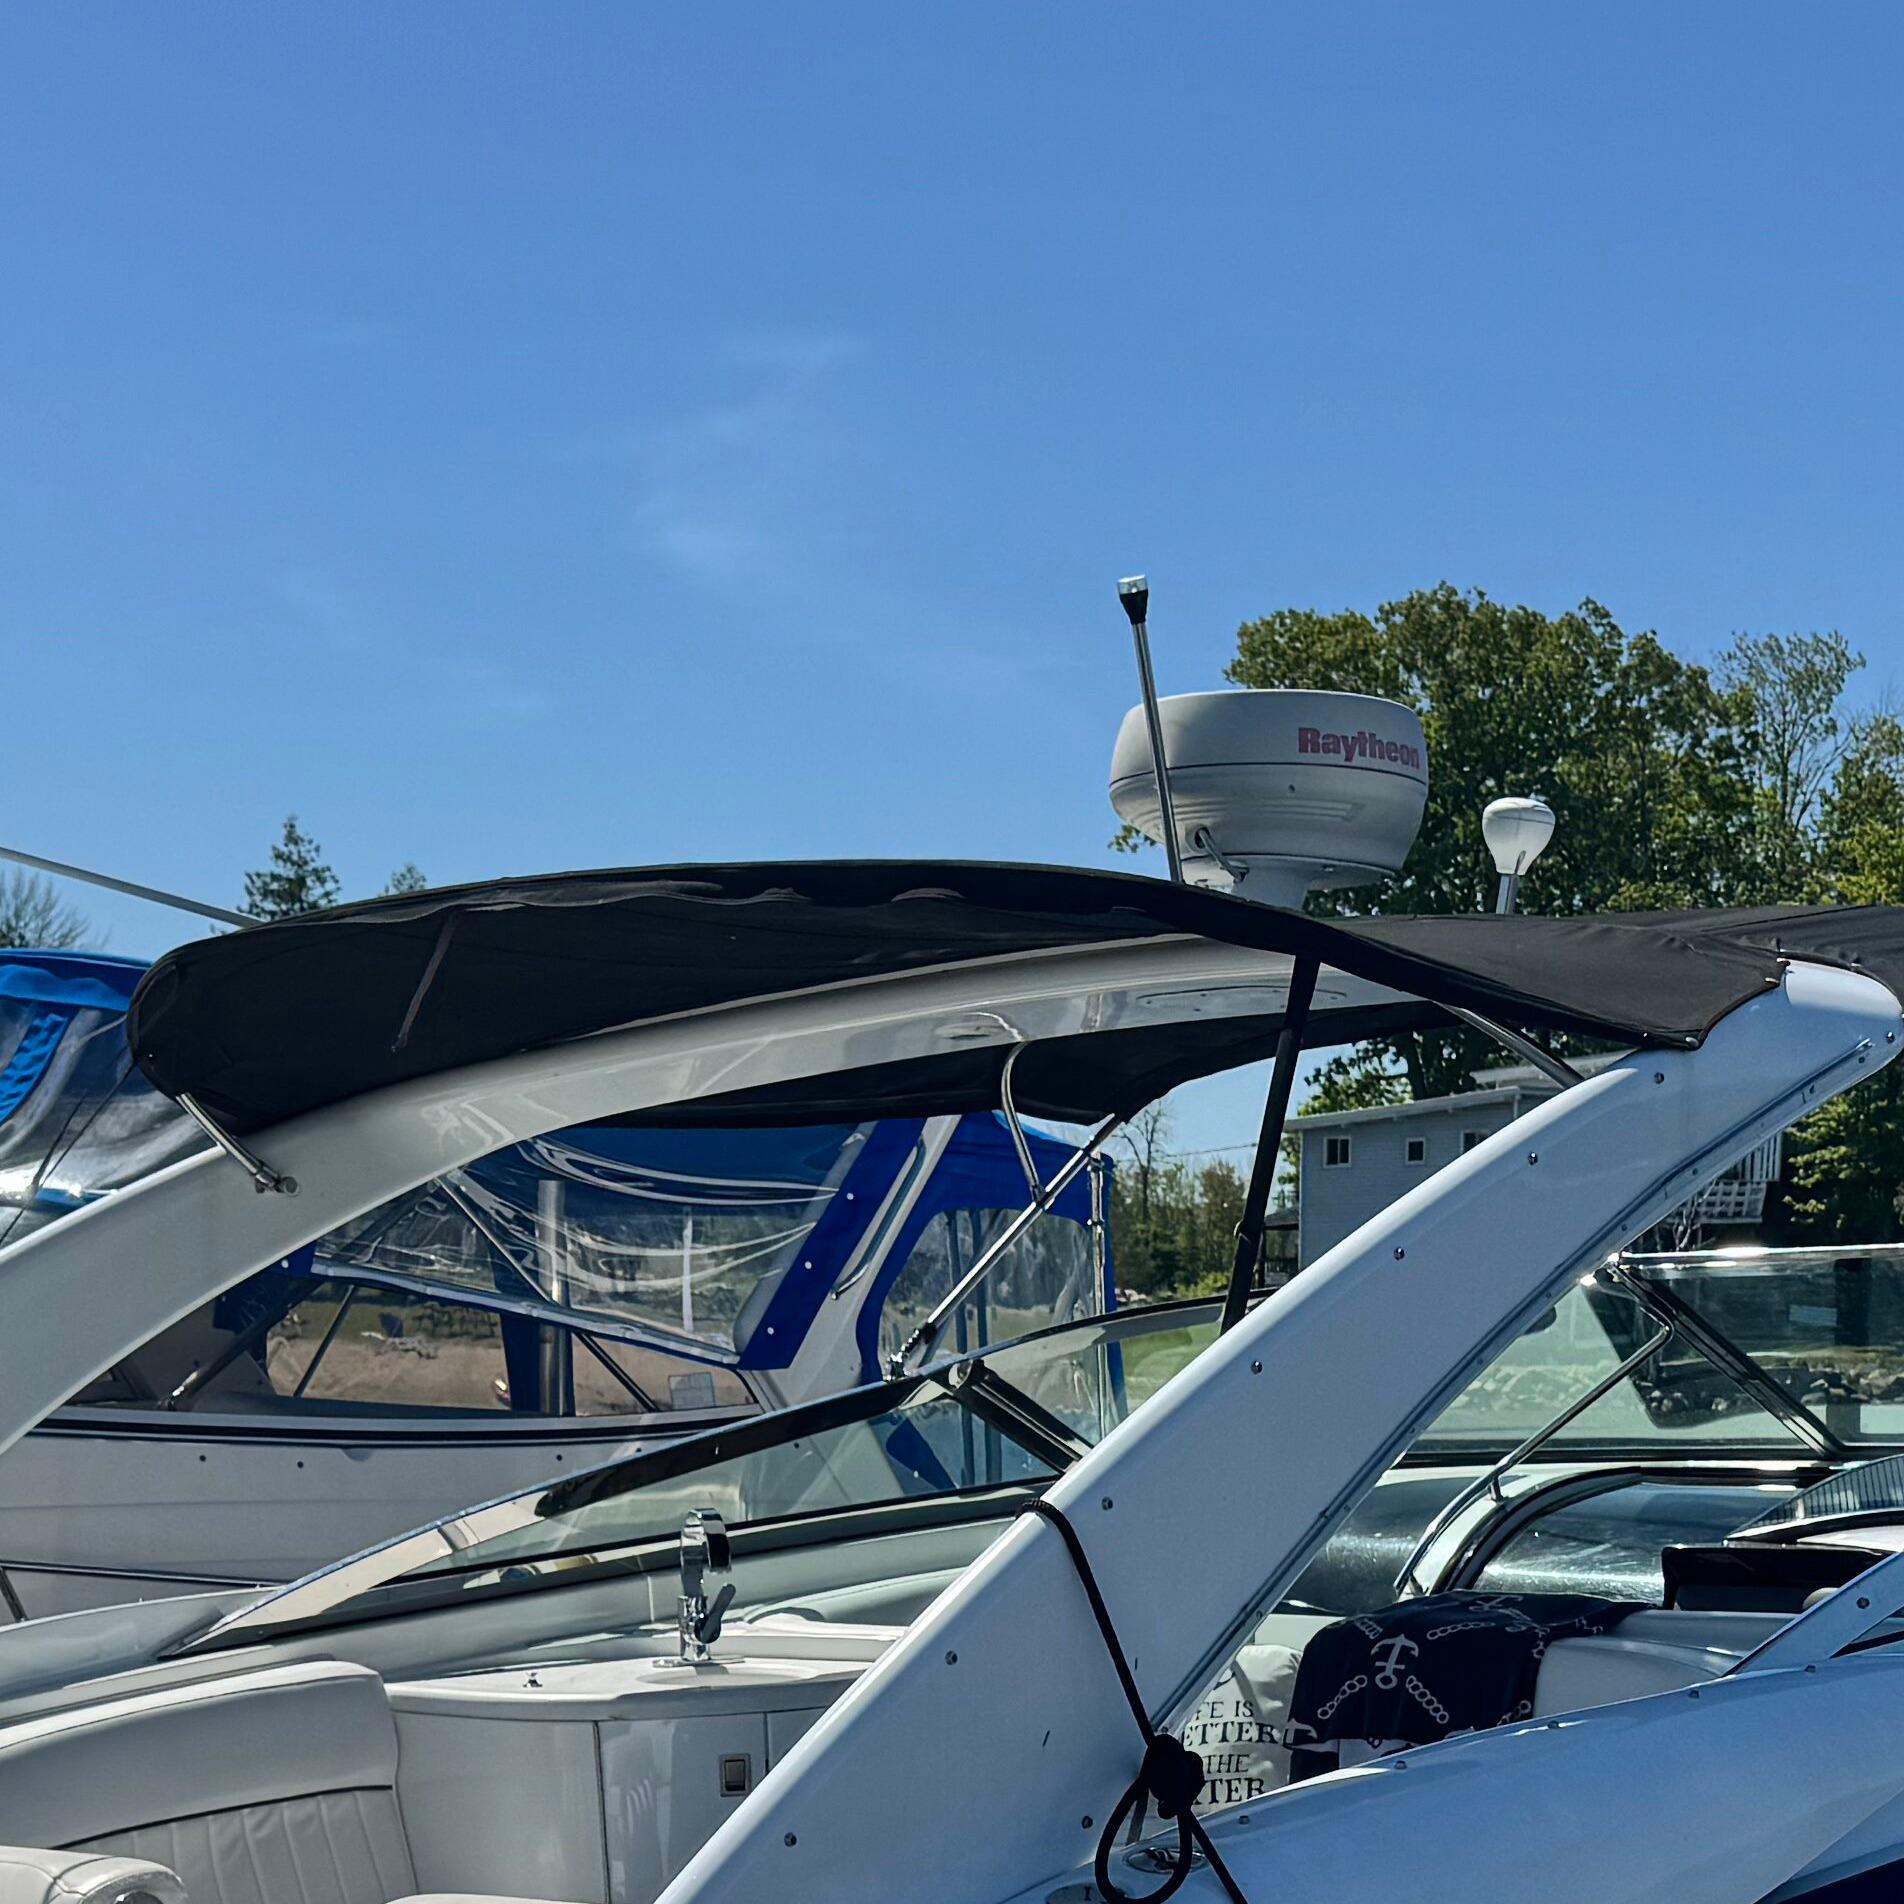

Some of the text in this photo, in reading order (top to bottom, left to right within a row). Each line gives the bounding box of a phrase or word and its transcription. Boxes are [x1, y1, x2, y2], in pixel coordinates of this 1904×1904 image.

[1298, 727, 1420, 770] Raytheon
[1196, 1700, 1254, 1720] FE IS
[1185, 1721, 1278, 1747] ETTER
[1203, 1754, 1250, 1774] THE
[1193, 1777, 1265, 1805] TER
